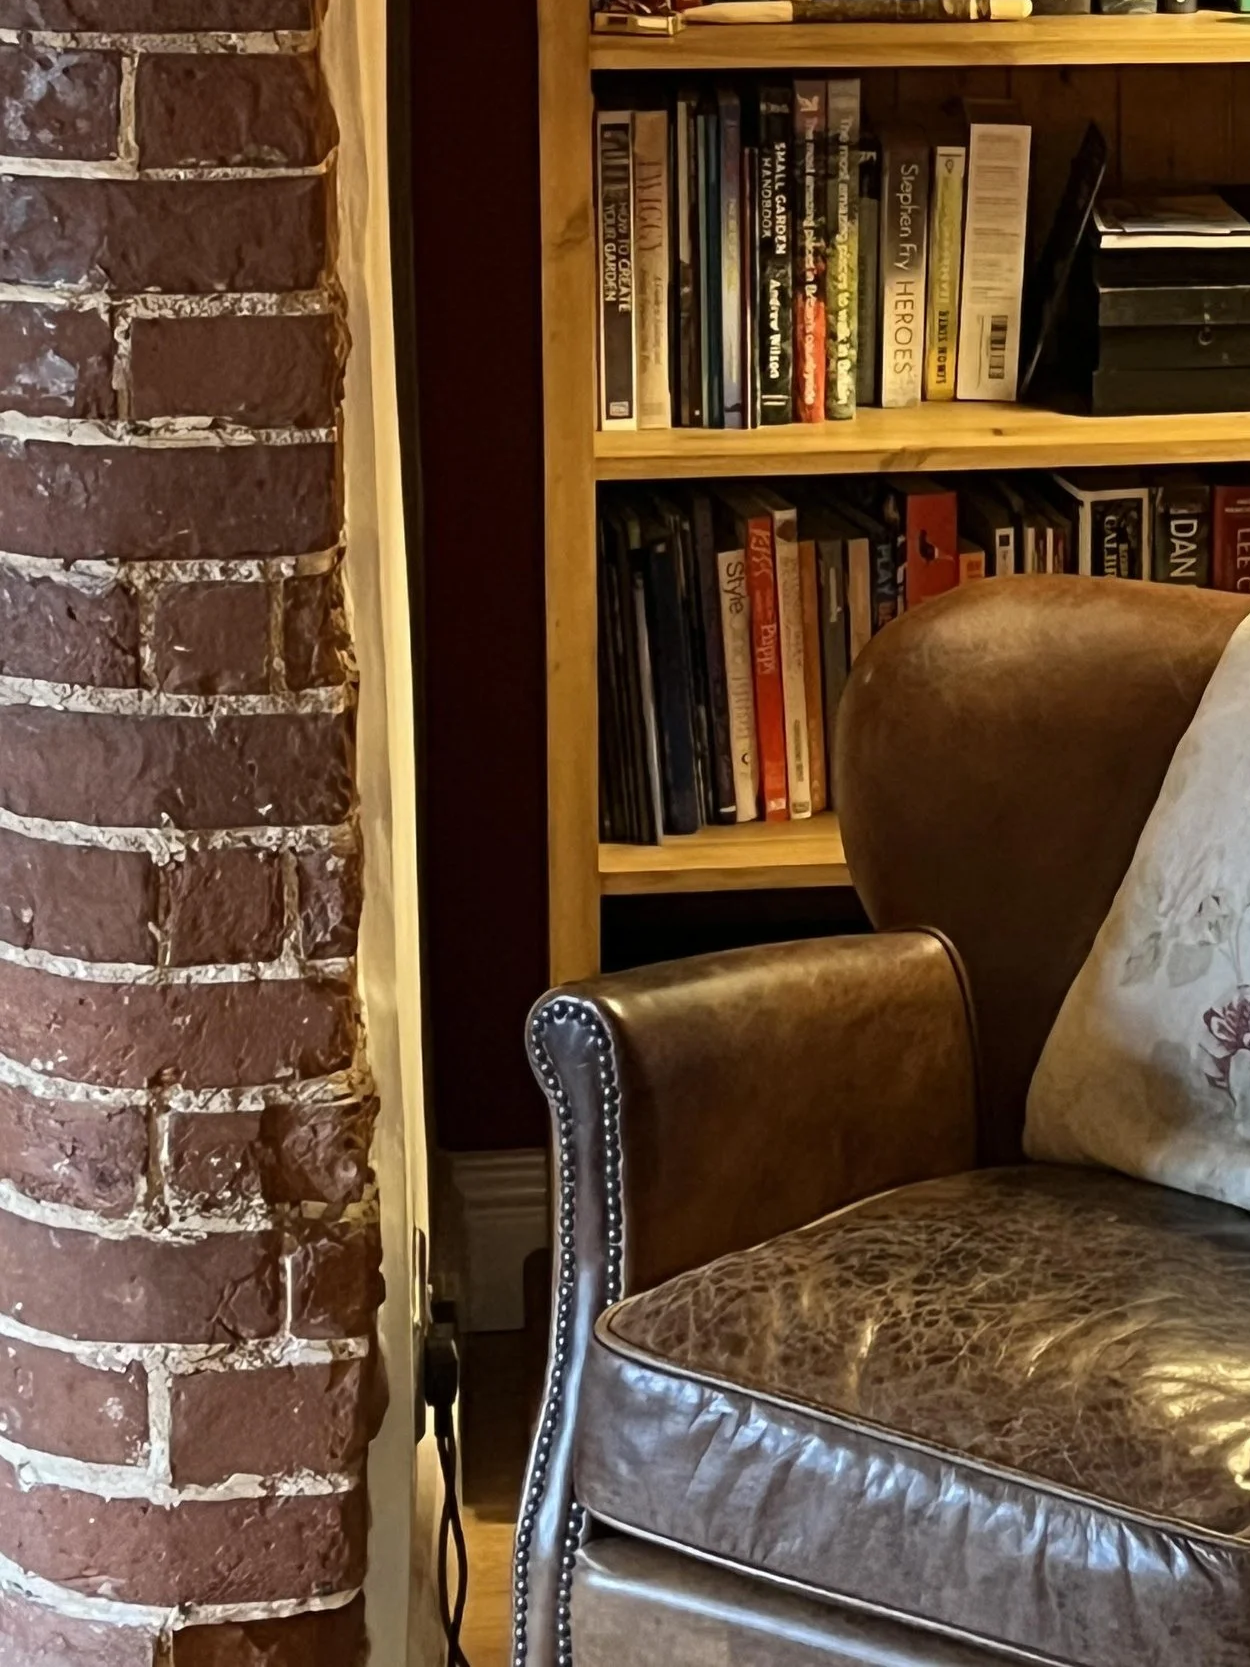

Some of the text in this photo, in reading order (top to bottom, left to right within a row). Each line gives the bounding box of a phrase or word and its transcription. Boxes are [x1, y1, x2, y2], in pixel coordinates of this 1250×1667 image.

[801, 116, 819, 142] The
[804, 142, 817, 173] most
[760, 157, 774, 239] HANDBOOK
[773, 142, 788, 255] SMALL GARDEN
[802, 175, 818, 227] amazing
[893, 163, 919, 271] Stephen Fry
[603, 242, 618, 302] GARDEN
[618, 238, 632, 255] TO
[802, 229, 818, 270] places
[834, 116, 852, 405] The most amazing places to walk in Britain
[617, 258, 633, 313] CREATE
[767, 278, 783, 379] Andrew Wilson
[892, 280, 915, 374] HEROES
[1169, 518, 1198, 578] DAN
[723, 561, 750, 615] Style
